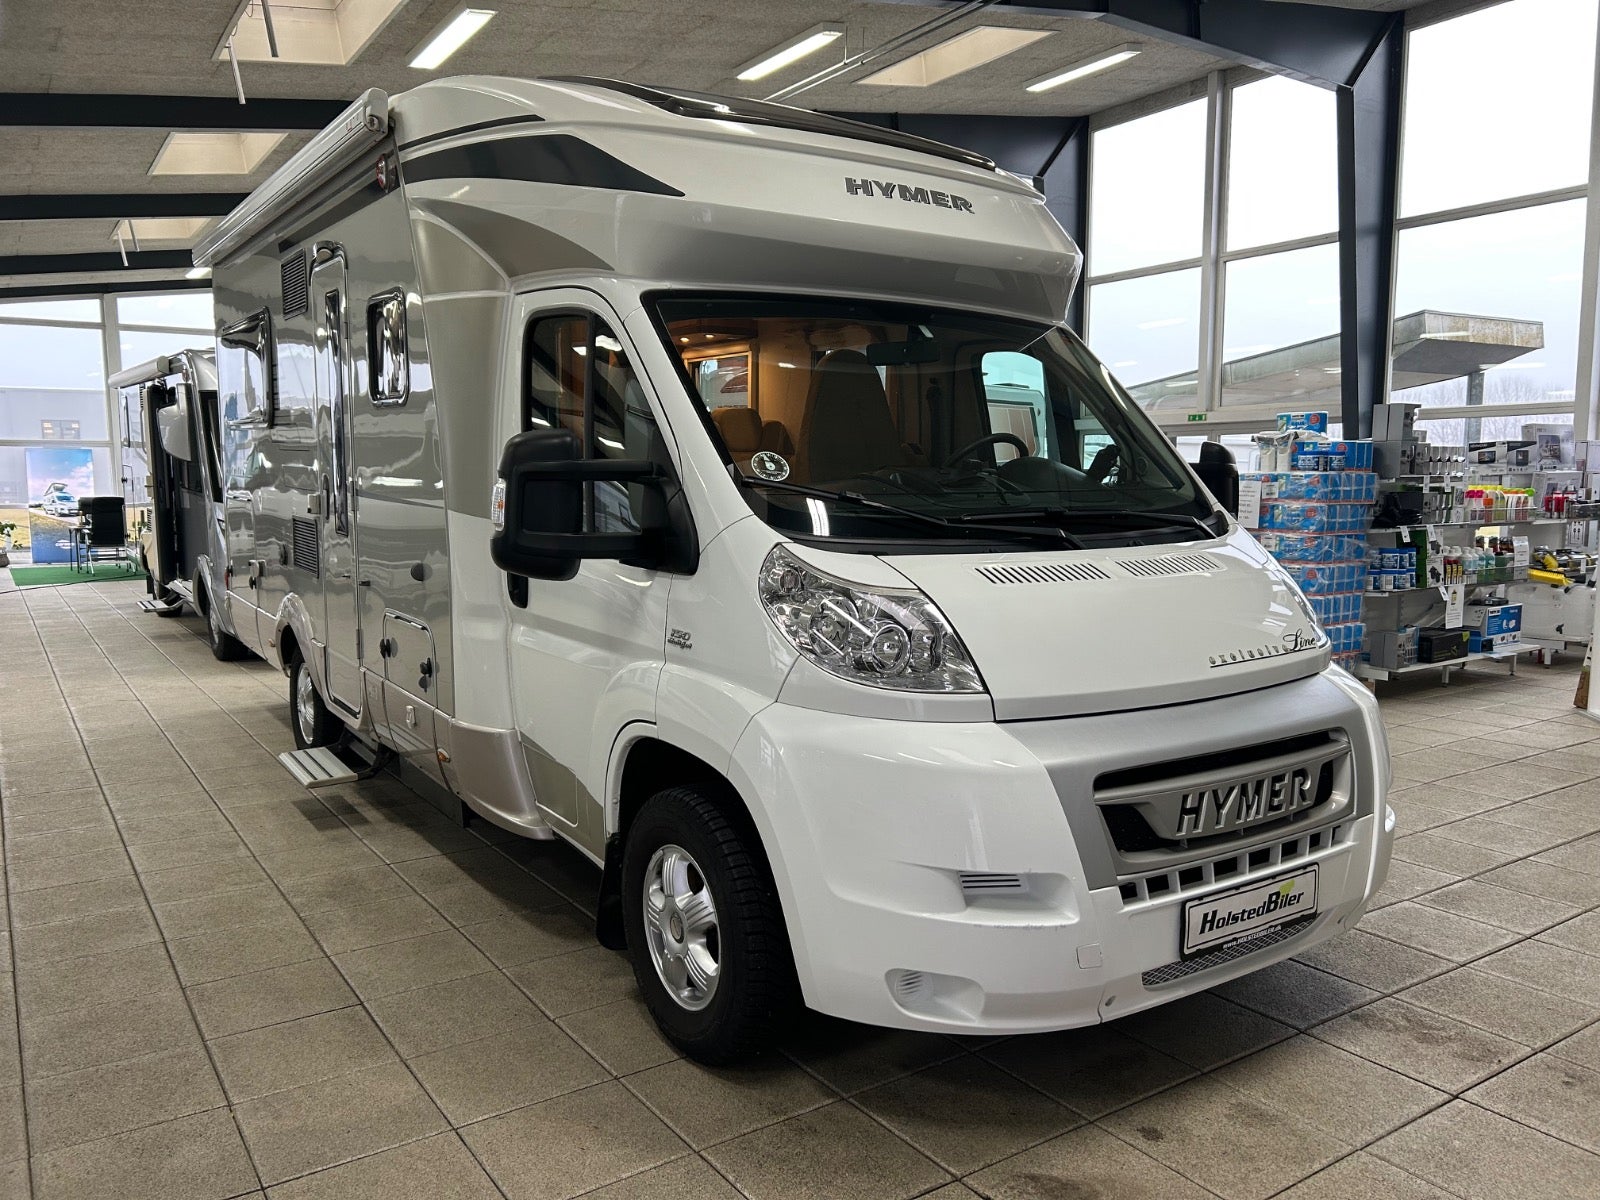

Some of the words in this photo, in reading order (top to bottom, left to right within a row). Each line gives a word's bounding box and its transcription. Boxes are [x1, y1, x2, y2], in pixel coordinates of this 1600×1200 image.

[844, 177, 975, 214] HYMER
[1208, 644, 1291, 665] exclusive
[1282, 628, 1316, 652] Line
[1175, 768, 1312, 836] HYMER
[1199, 889, 1304, 935] HolstedBiler
